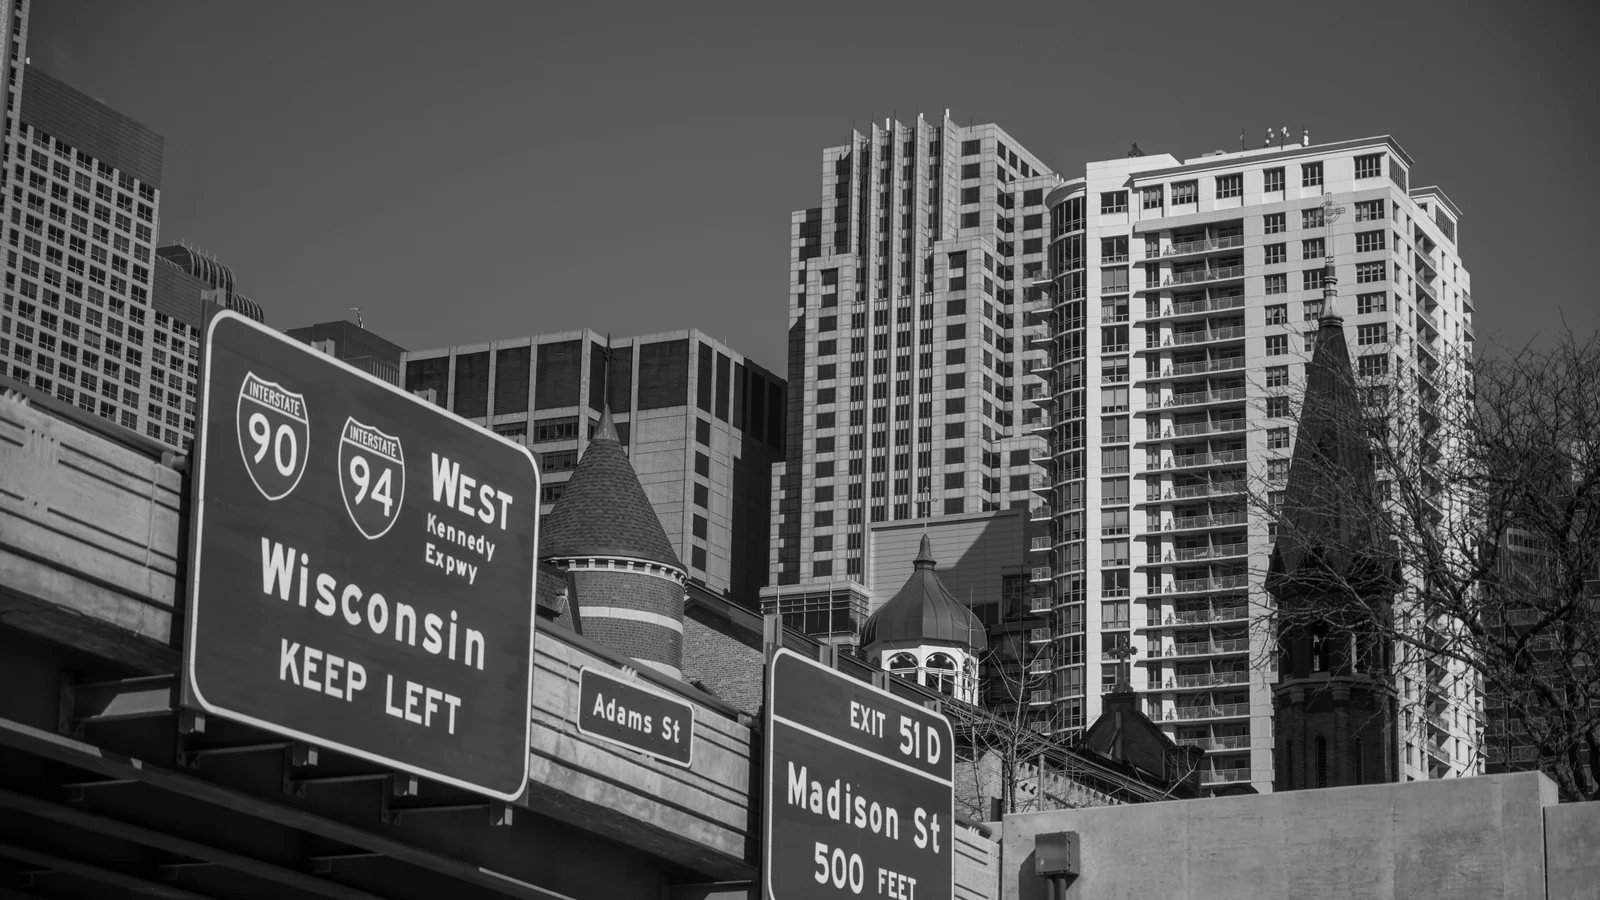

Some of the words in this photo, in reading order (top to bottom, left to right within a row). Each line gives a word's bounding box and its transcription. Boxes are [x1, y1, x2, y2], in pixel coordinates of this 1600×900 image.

[250, 381, 301, 417] INTERSTATE
[248, 412, 298, 477] 90
[350, 424, 397, 458] INTERSTATE
[350, 455, 394, 518] 94
[431, 452, 513, 531] WEST
[425, 541, 478, 585] Expwy
[427, 512, 496, 562] Kennedy
[261, 536, 485, 671] Wisconsin
[279, 637, 367, 702] KEEP
[385, 673, 462, 735] LEFT
[593, 692, 652, 734] Adams
[661, 716, 681, 744] St
[850, 700, 886, 739] EXIT
[787, 760, 899, 841] Madison
[913, 806, 941, 854] St
[814, 841, 865, 895] 500
[878, 867, 917, 900] FEET
